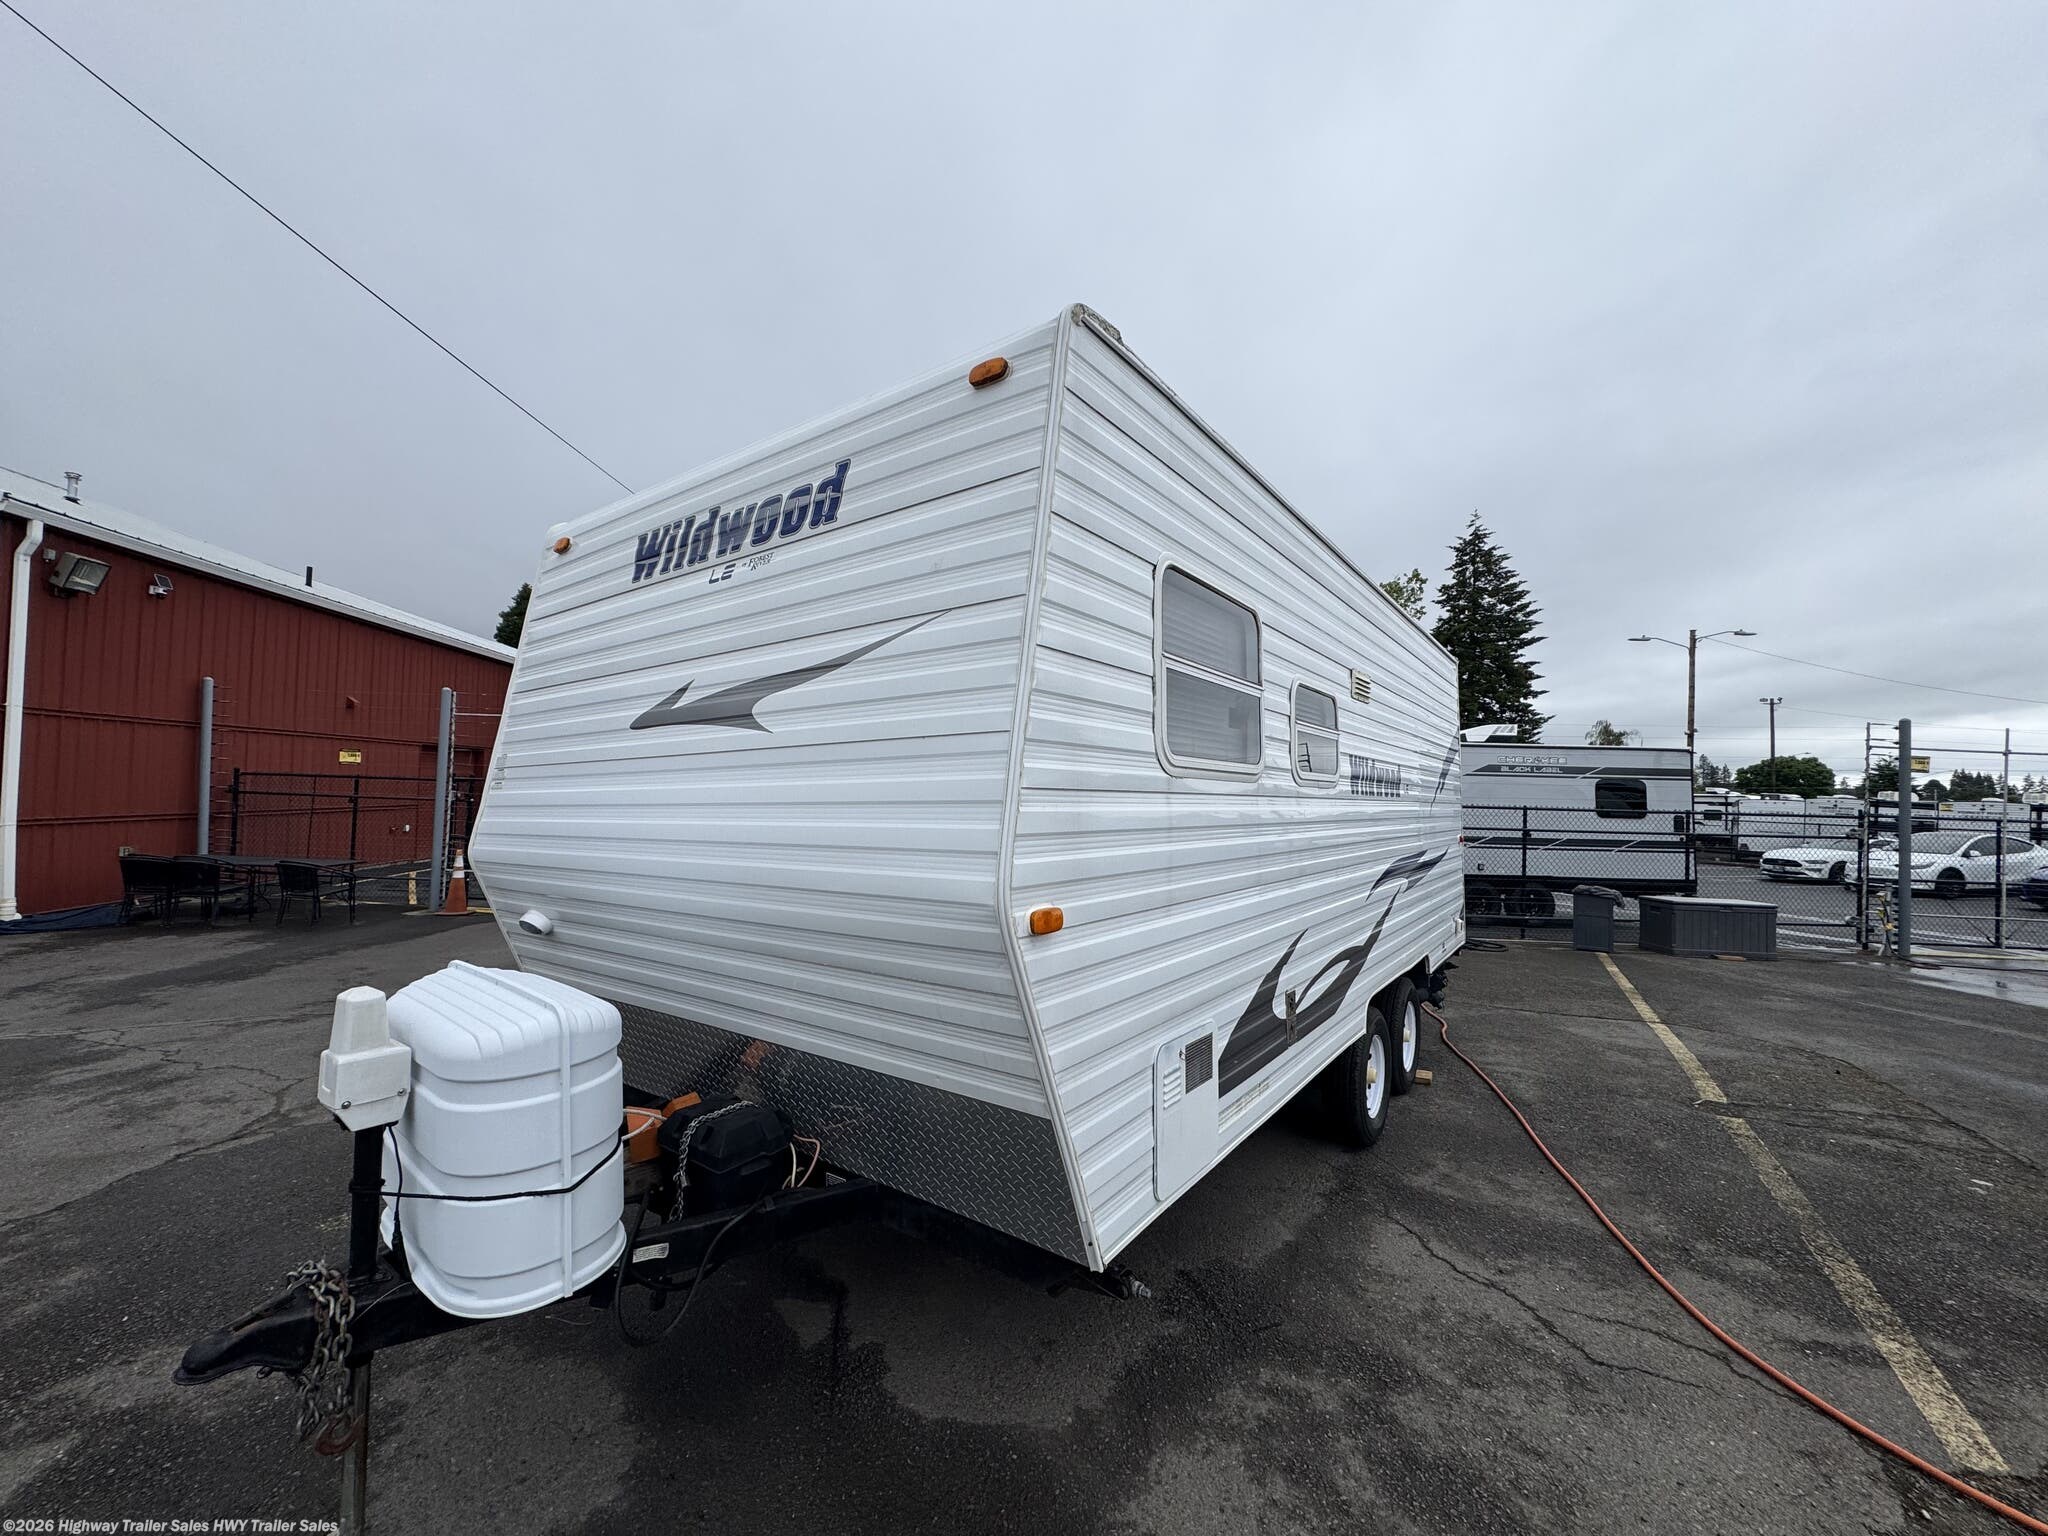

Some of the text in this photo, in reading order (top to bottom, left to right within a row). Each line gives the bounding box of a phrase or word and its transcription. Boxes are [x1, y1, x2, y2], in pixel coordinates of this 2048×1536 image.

[631, 458, 851, 583] Wildwood
[708, 562, 737, 585] LE
[1349, 754, 1402, 798] Wildwood
[1500, 765, 1563, 774] BLACK LABEL
